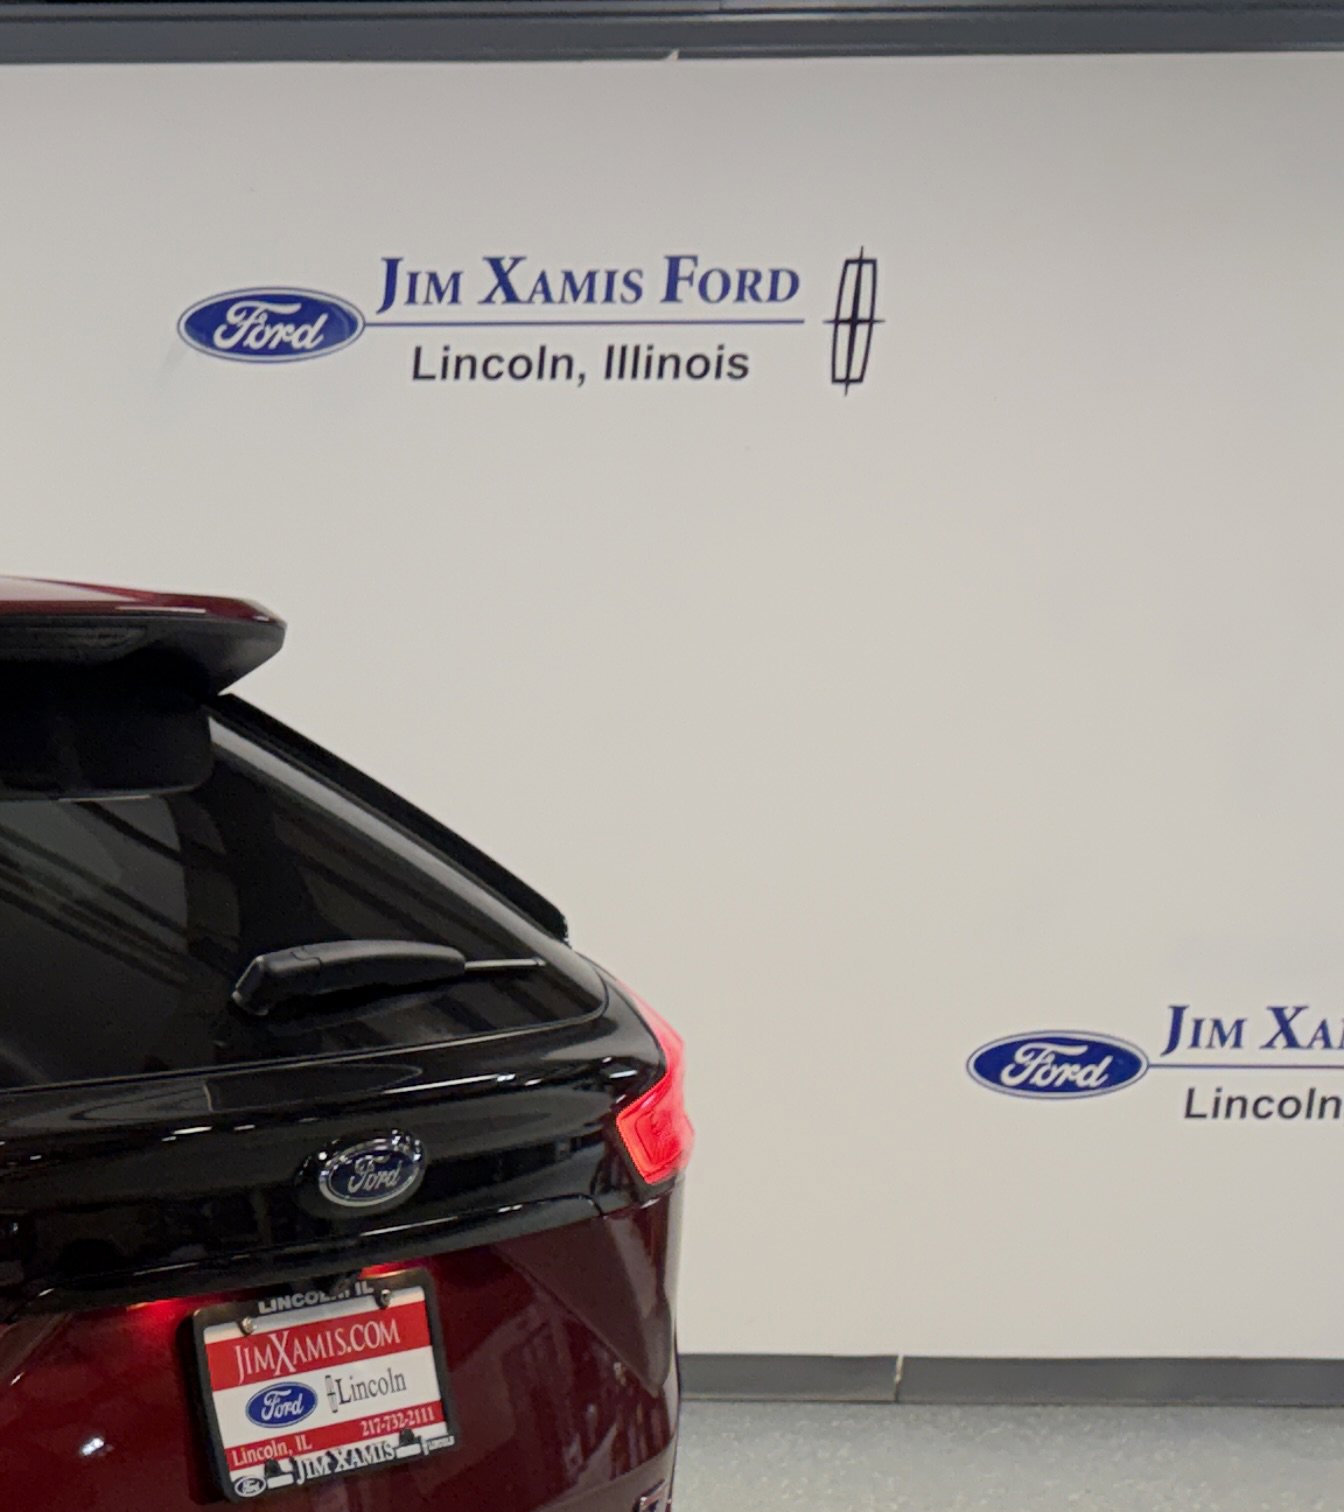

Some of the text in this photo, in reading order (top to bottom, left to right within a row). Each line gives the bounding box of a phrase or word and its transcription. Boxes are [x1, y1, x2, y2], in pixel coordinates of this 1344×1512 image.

[376, 254, 801, 315] JIM XAMIS FORD
[212, 299, 325, 350] Ford
[411, 343, 751, 386] Lincoln, Illinois
[1160, 1004, 1248, 1056] JIM
[1000, 1042, 1114, 1088] Ford
[347, 1154, 404, 1194] Ford
[234, 1318, 401, 1385] JIMXAMIS.COM
[261, 1388, 305, 1421] Ford
[334, 1368, 407, 1405] Lincoln
[231, 1434, 313, 1467] Lincoln, IL
[296, 1455, 331, 1485] JIM
